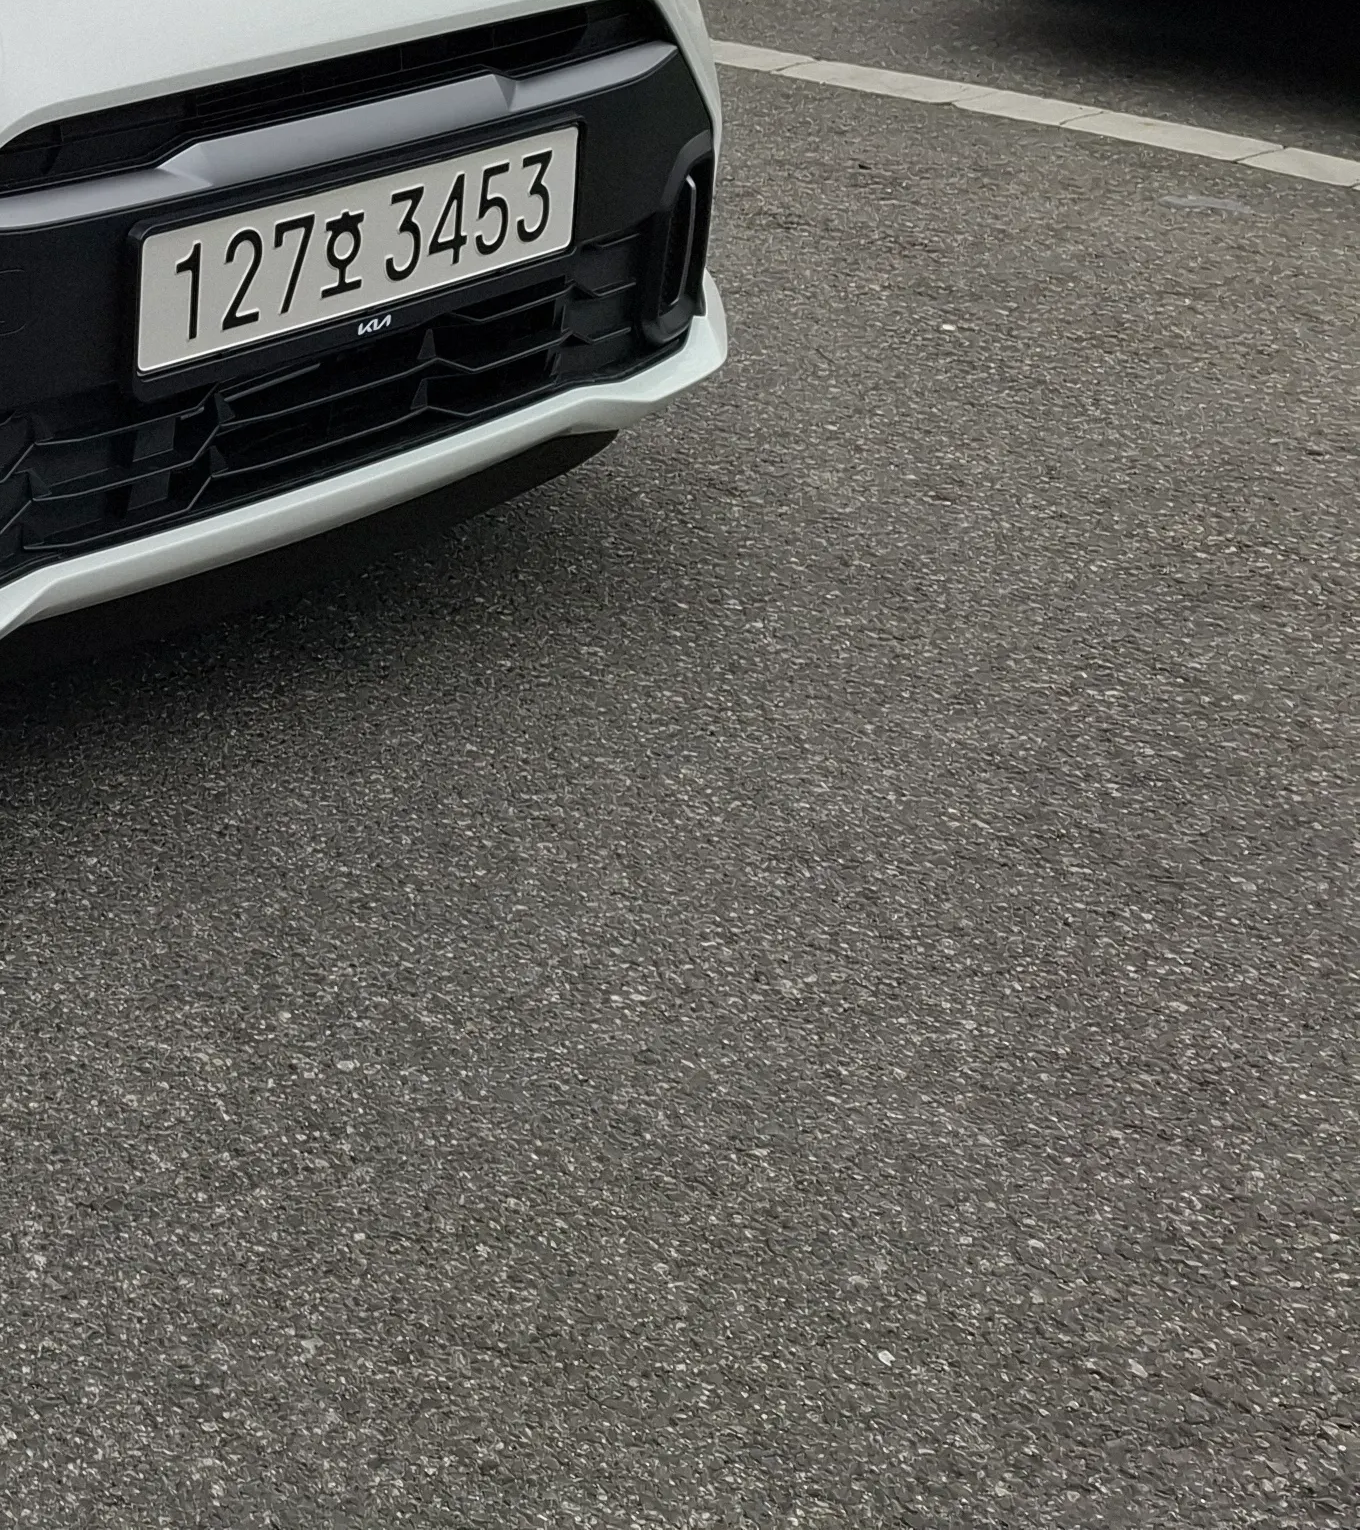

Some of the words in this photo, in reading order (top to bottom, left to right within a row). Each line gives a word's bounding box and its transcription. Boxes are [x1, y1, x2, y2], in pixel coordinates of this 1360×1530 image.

[175, 209, 365, 341] 127호
[385, 149, 553, 281] 3453
[357, 314, 392, 336] KIA
